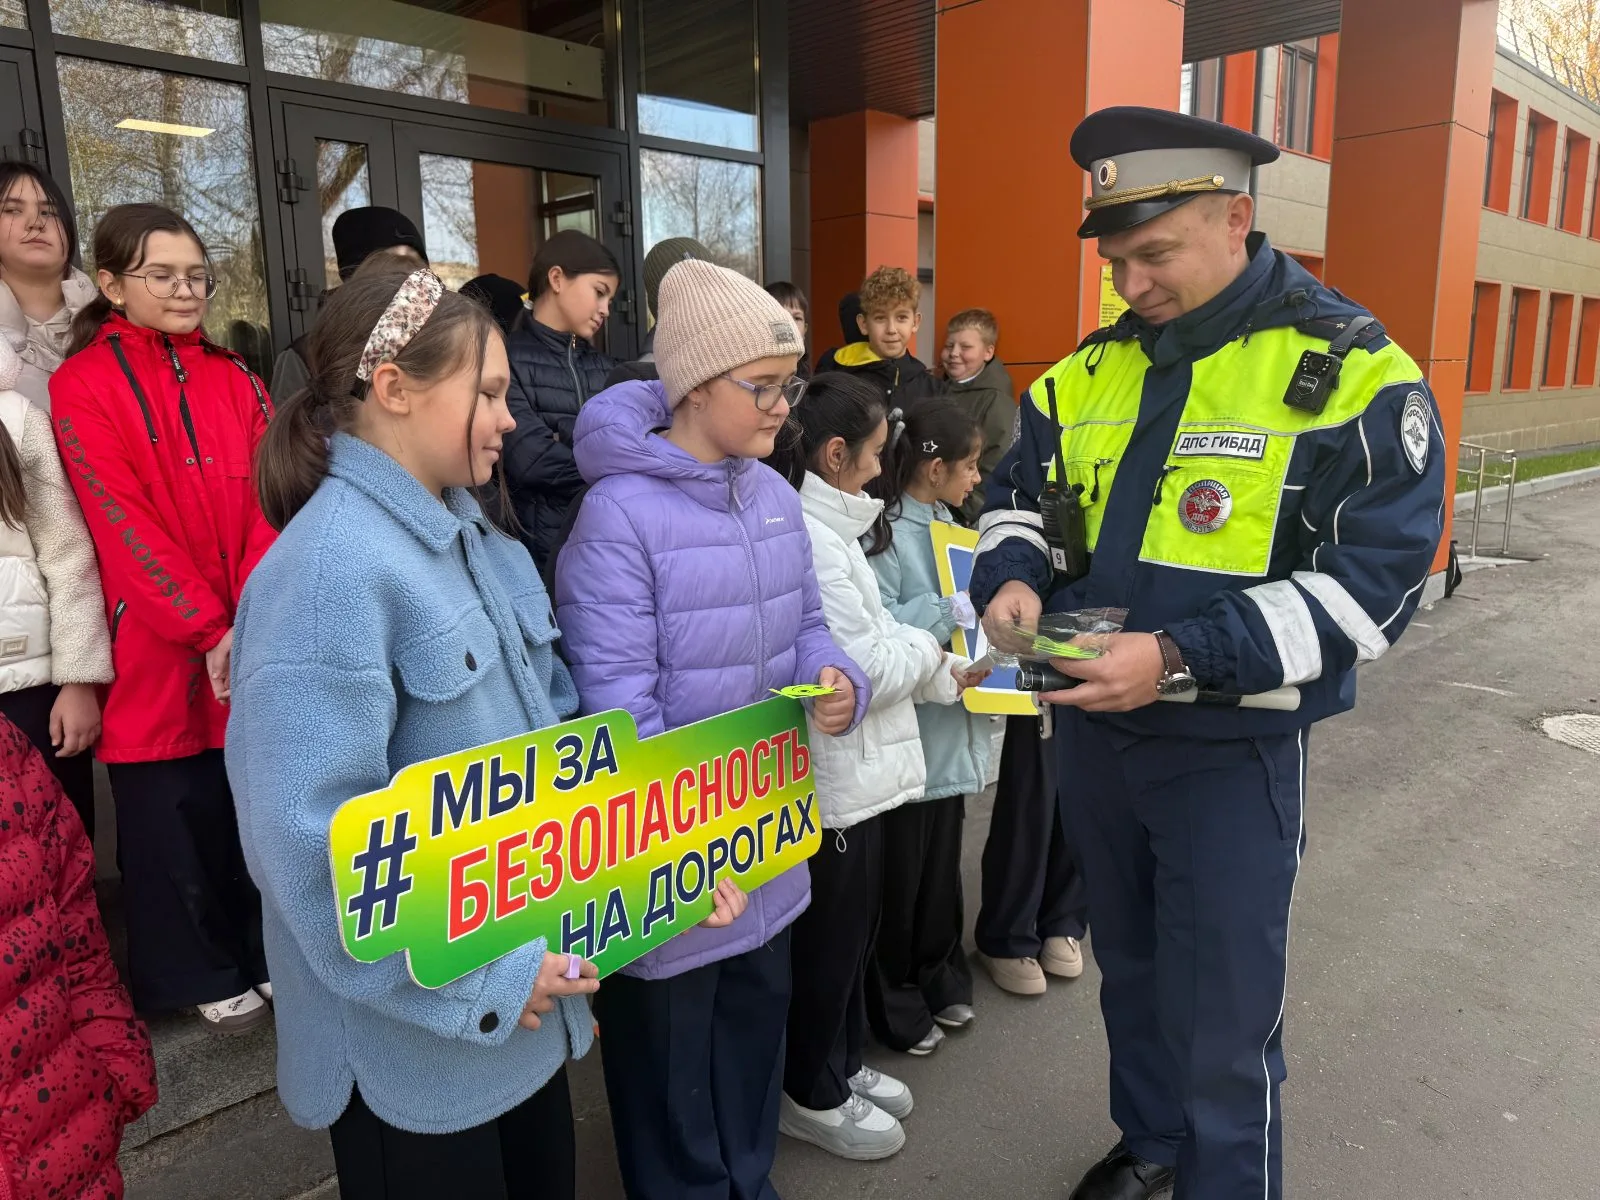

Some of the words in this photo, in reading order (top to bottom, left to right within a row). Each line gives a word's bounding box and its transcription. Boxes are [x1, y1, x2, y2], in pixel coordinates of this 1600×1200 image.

[1179, 436, 1208, 451] ДПС
[1210, 436, 1261, 454] ГИБДД
[1187, 480, 1230, 499] ПОЛИЦИЯ
[1191, 513, 1209, 522] ДПС
[119, 527, 200, 620] FASHION
[1056, 552, 1062, 565] 9
[430, 745, 536, 838] МЫ
[553, 724, 619, 791] ЗА
[447, 727, 810, 943] БЕЗОПАСНОСТЬ
[560, 887, 632, 959] НА
[642, 792, 816, 939] ДОРОГАХ
